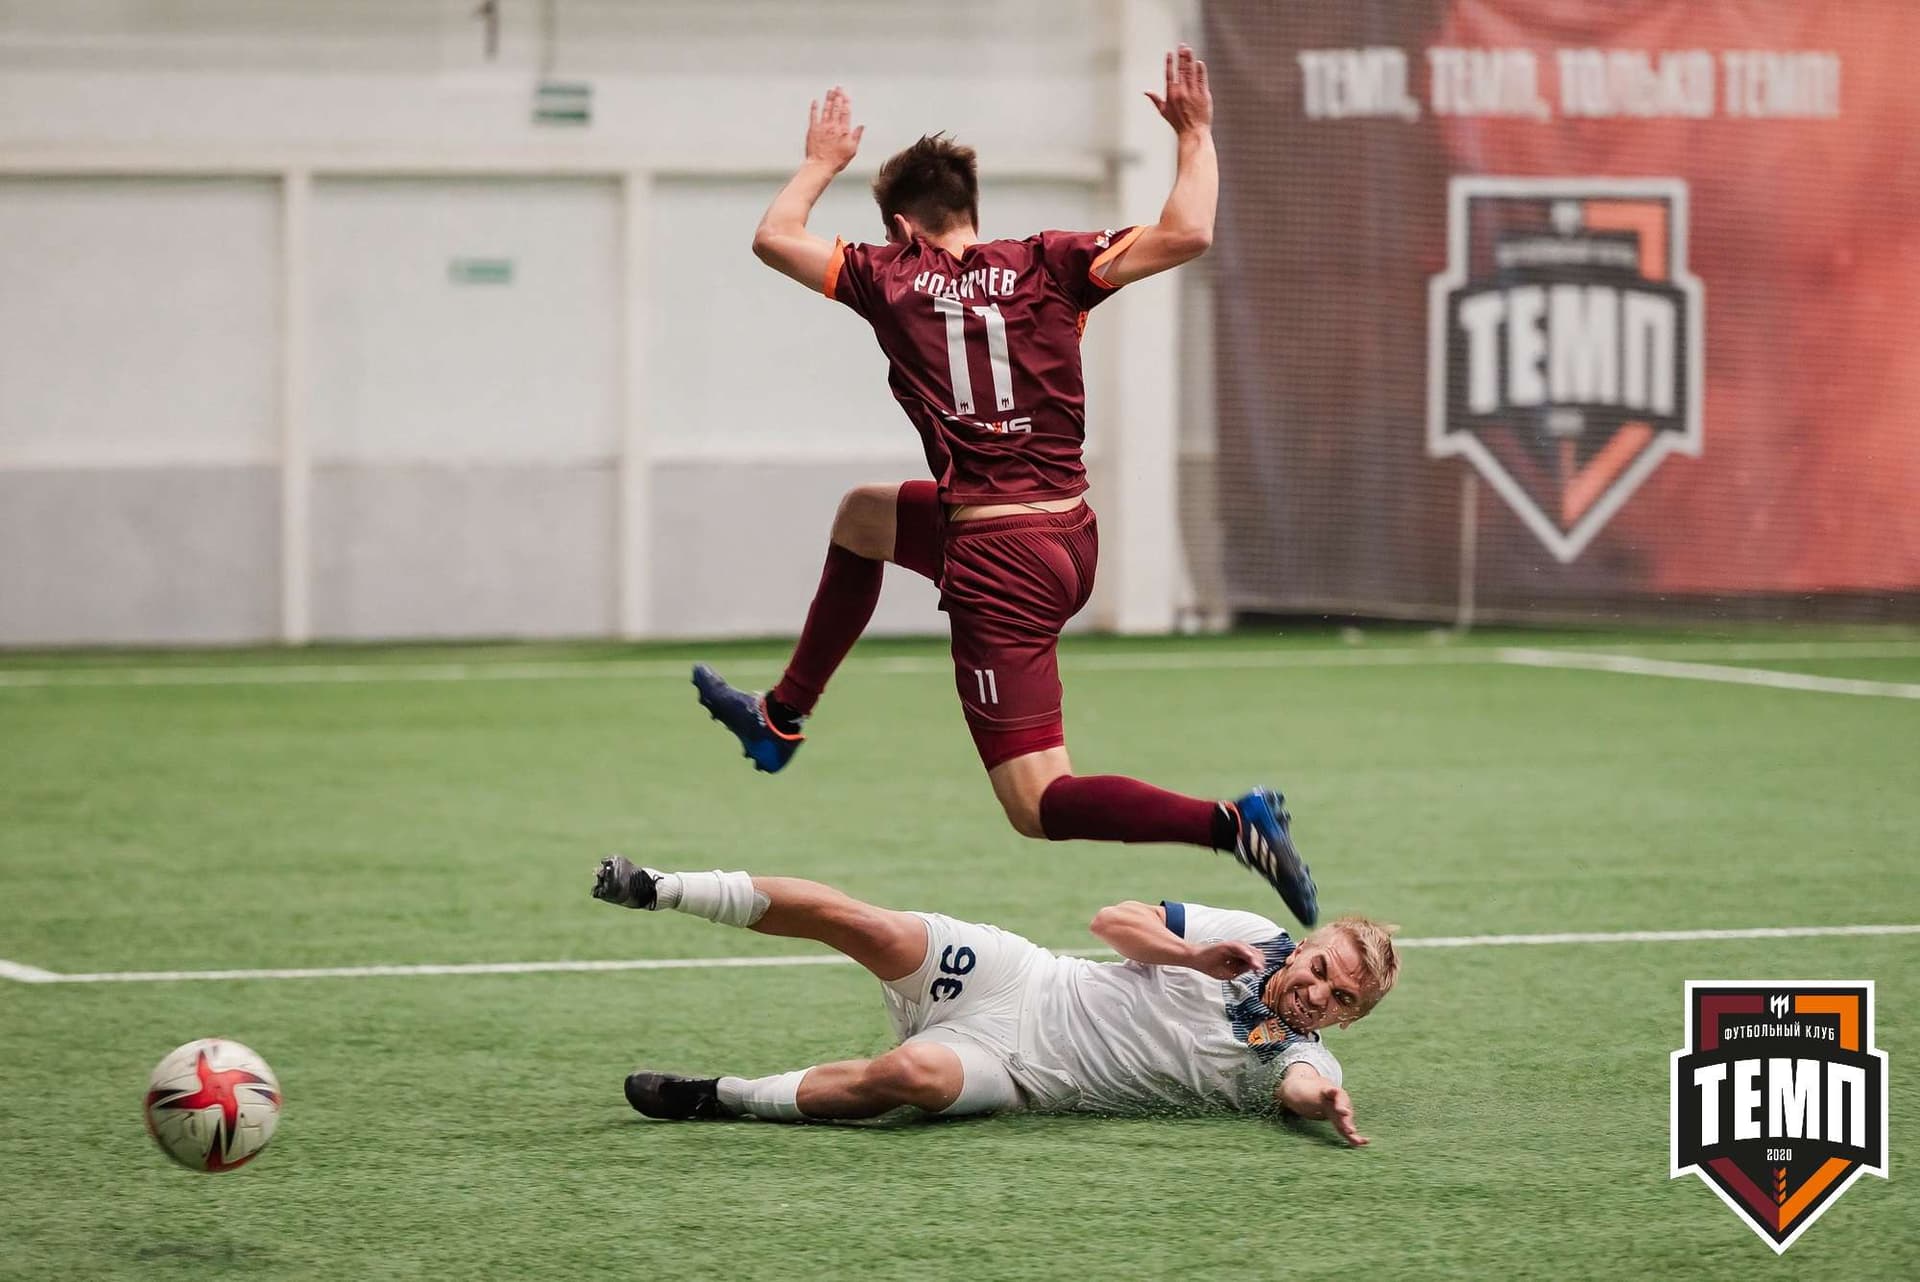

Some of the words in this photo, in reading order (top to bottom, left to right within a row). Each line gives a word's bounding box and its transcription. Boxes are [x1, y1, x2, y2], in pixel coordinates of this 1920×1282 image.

[933, 298, 1015, 416] 11
[1459, 284, 1677, 416] ТЕМП
[974, 669, 999, 704] 11
[930, 945, 976, 1003] 36
